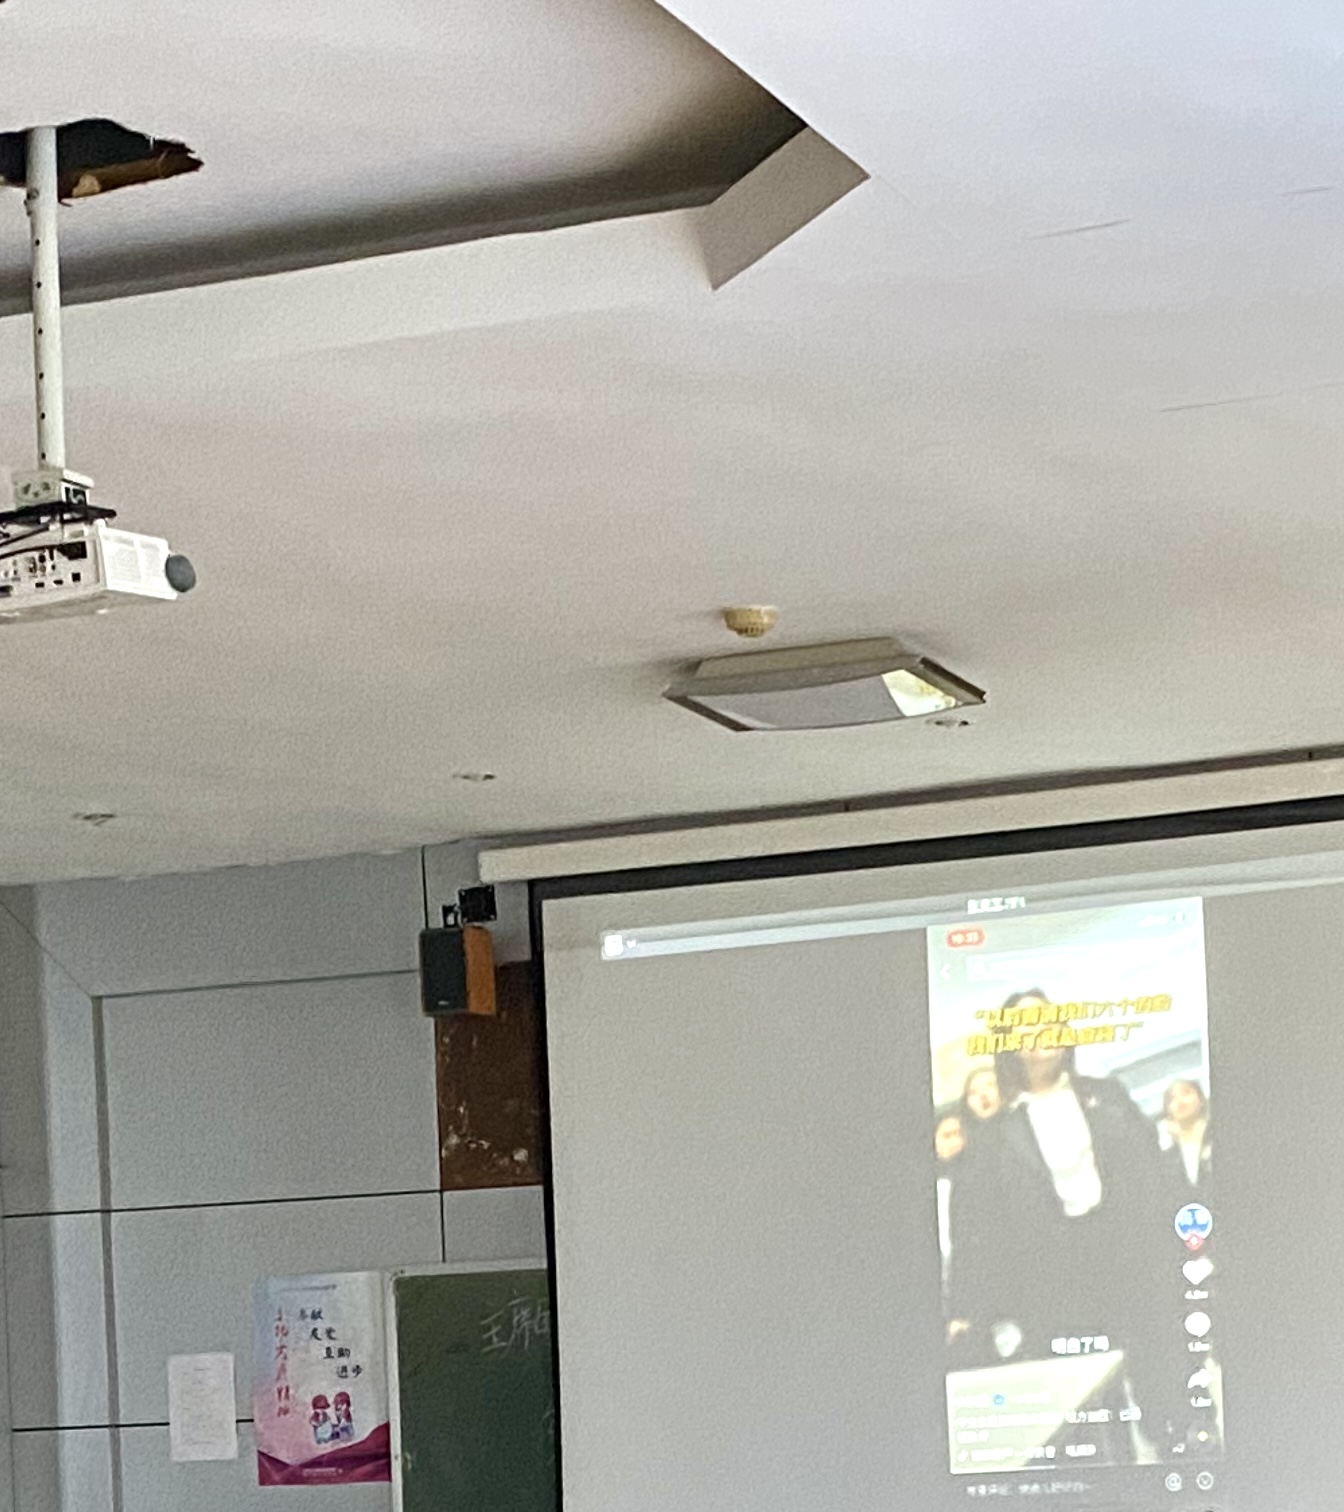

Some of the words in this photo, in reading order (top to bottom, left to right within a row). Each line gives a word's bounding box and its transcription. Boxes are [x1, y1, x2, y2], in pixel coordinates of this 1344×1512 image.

[297, 1306, 324, 1322] 奉献
[309, 1327, 337, 1342] 友爱
[323, 1346, 351, 1360] 互助
[337, 1364, 363, 1379] 进步
